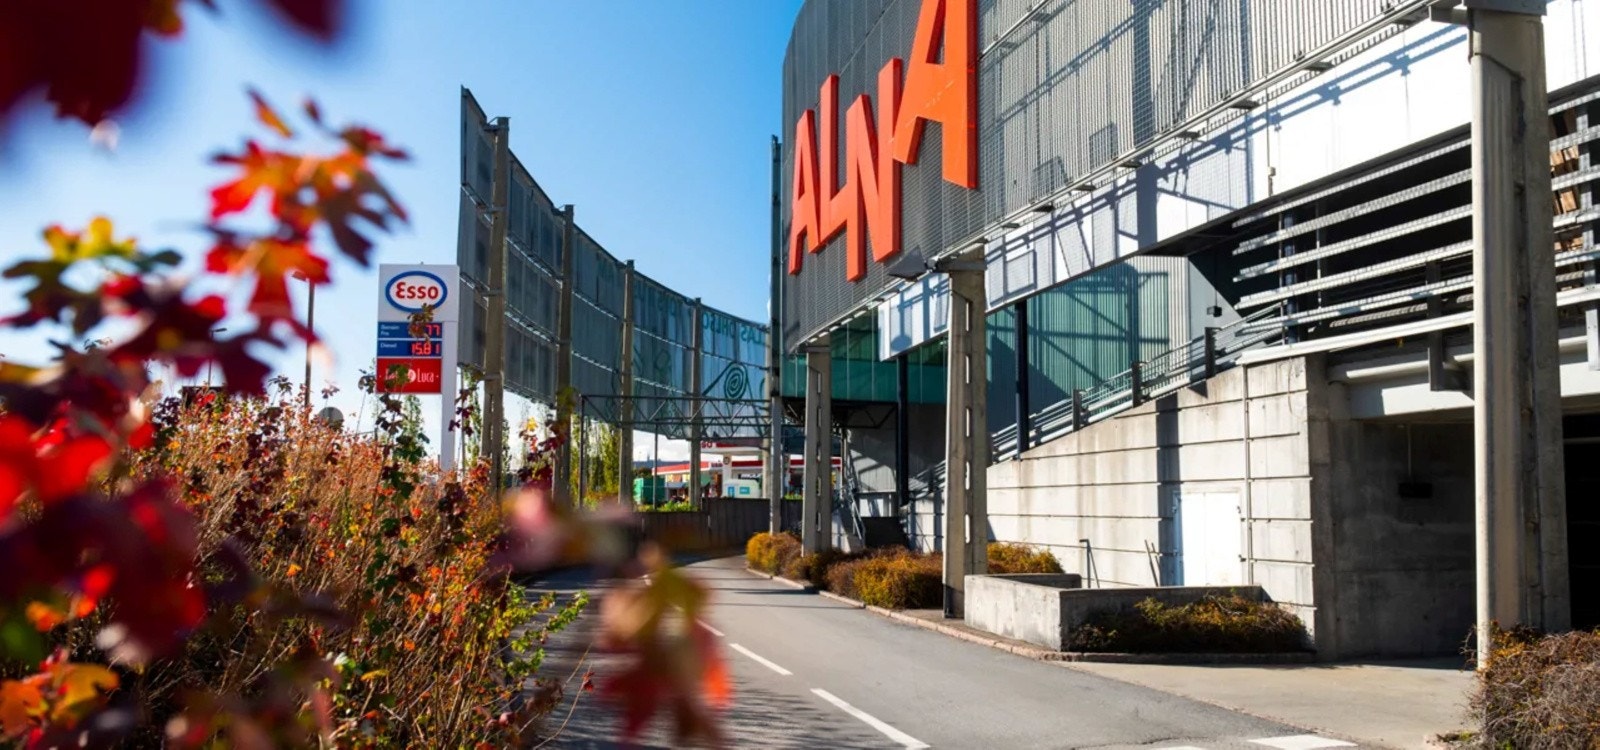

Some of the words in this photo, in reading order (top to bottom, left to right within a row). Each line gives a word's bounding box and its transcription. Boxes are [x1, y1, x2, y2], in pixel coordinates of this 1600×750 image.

[788, 0, 977, 282] ALNA
[395, 281, 439, 300] Esso
[417, 368, 434, 383] Luca
